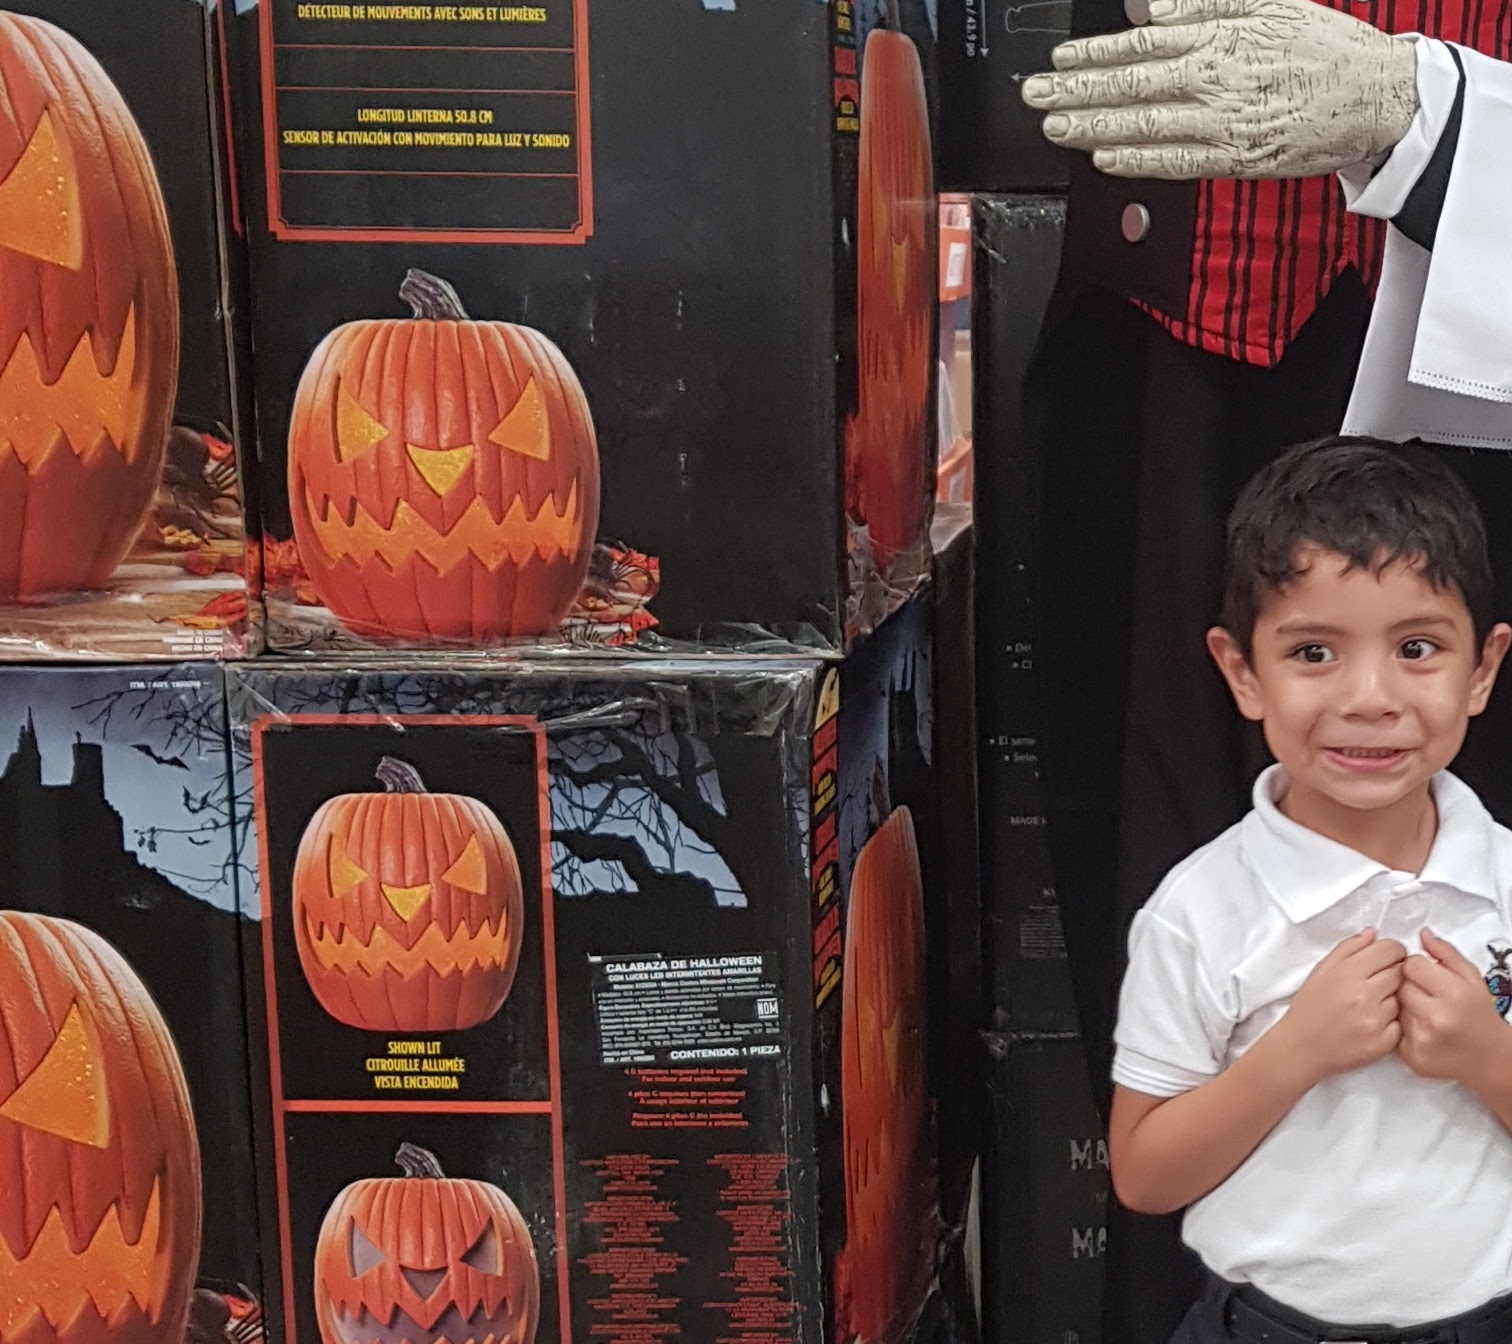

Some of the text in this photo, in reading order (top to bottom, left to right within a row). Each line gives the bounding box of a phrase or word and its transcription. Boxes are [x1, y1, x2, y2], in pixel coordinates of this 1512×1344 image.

[606, 956, 762, 973] CALABAZA DE HALLOWEEN
[757, 1001, 778, 1015] NOM
[388, 1042, 441, 1054] SHOWN LIT
[671, 1048, 739, 1059] CONTENIDO:
[750, 1045, 780, 1055] PIEZA
[366, 1057, 465, 1072] CITROUILLE ALLUMÉE
[375, 1076, 459, 1089] VISTA ENCENDIDA
